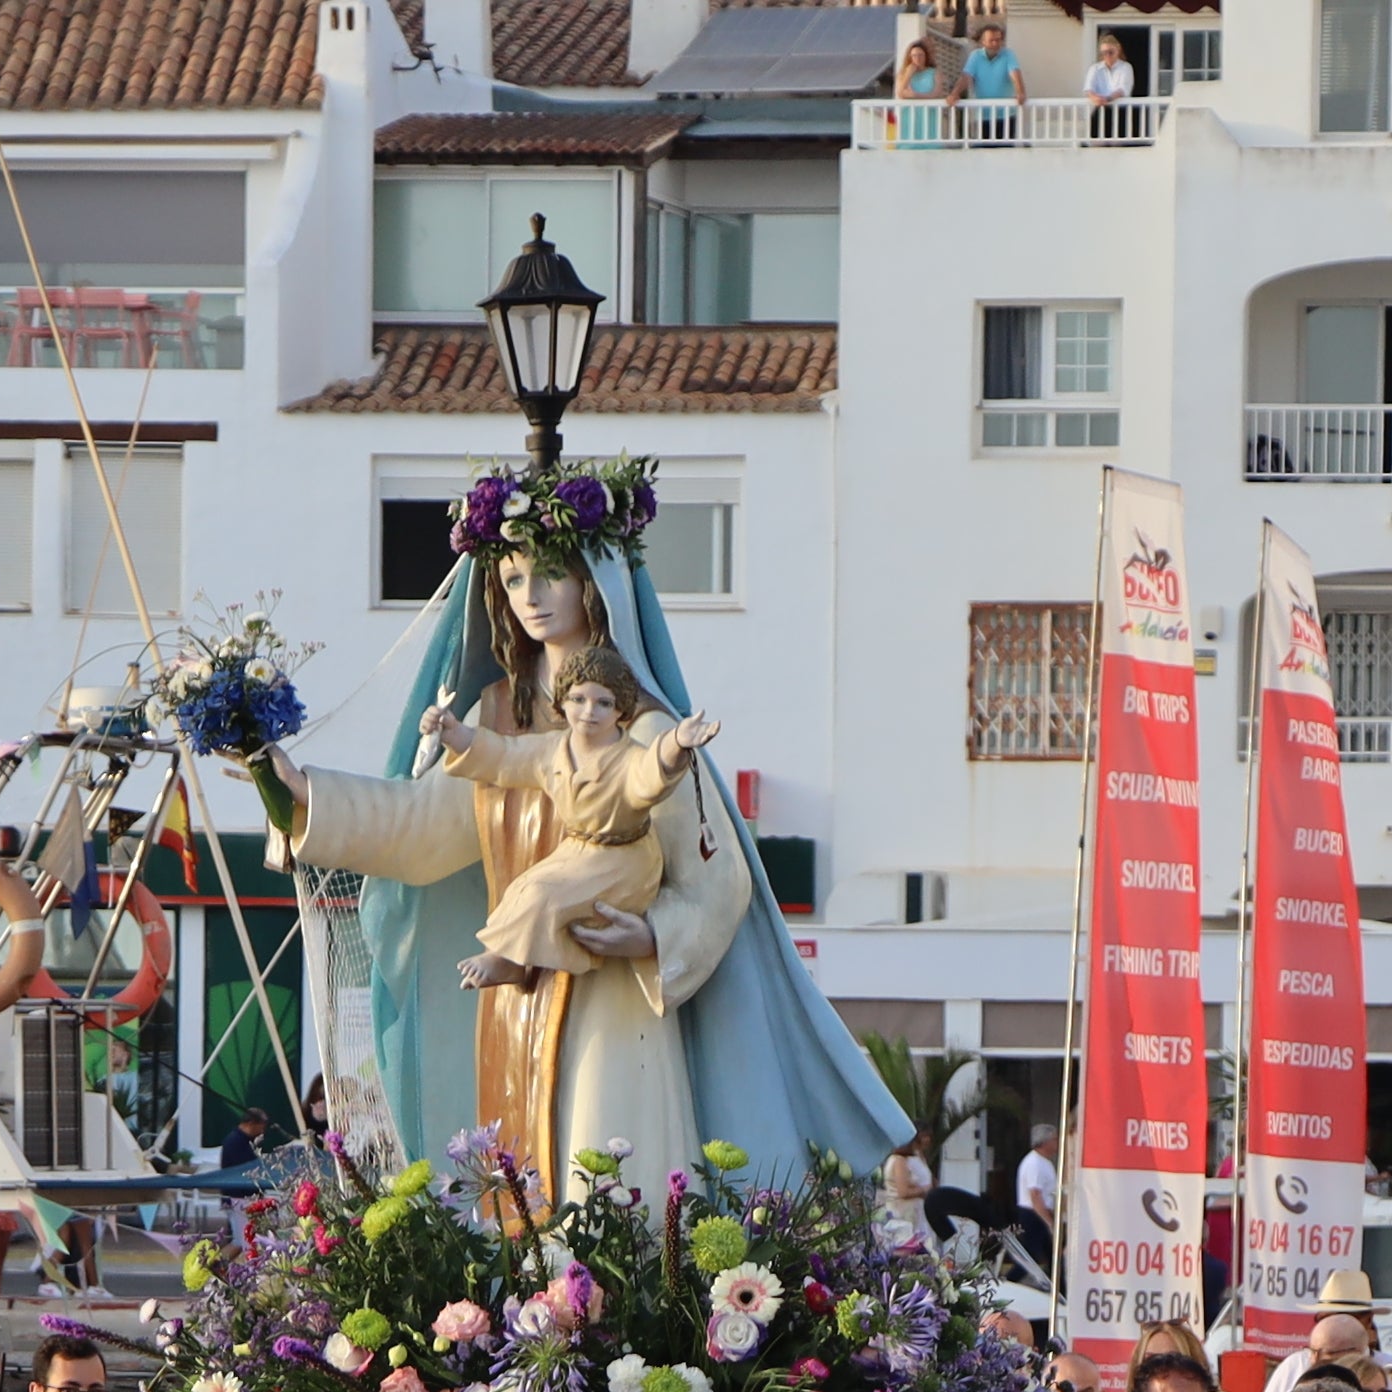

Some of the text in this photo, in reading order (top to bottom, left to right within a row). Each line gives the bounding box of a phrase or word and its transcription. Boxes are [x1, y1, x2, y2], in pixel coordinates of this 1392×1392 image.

[1152, 691, 1190, 723] TRIPS
[1301, 756, 1339, 786] BARC
[1106, 770, 1200, 807] SCUBA DIVIN
[1294, 827, 1344, 856] BUCEO
[1121, 859, 1196, 892] SNORKEL
[1103, 944, 1163, 977] FISHING
[1278, 969, 1334, 998] PESCA
[1124, 1032, 1192, 1066] SUNSETS
[1126, 1118, 1189, 1151] PARTIES
[1270, 1222, 1289, 1253] 04
[1297, 1224, 1322, 1255] 16
[1328, 1225, 1355, 1257] 67
[1088, 1239, 1129, 1275] 950
[1136, 1241, 1165, 1277] 04
[1172, 1243, 1193, 1278] 16
[1268, 1265, 1287, 1297] 85
[1294, 1267, 1320, 1299] 04
[1086, 1287, 1127, 1323] 657
[1134, 1291, 1162, 1324] 85
[1170, 1292, 1191, 1321] 04
